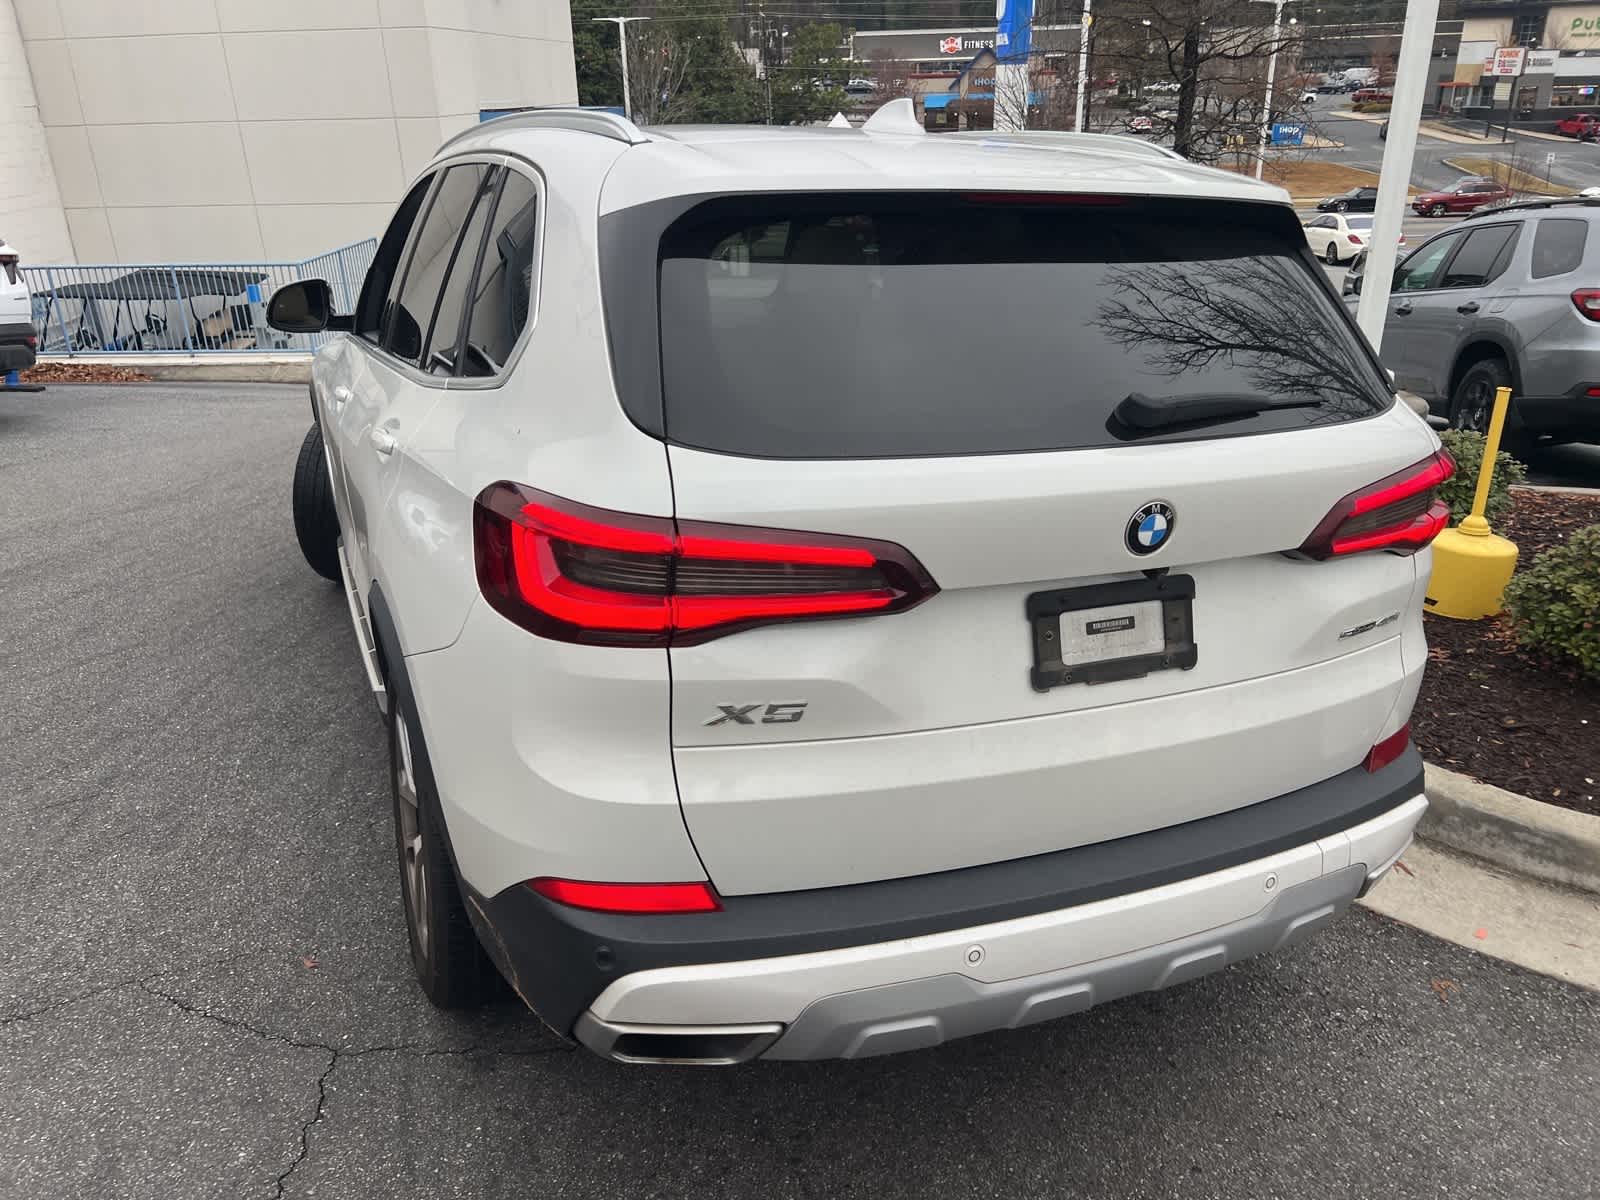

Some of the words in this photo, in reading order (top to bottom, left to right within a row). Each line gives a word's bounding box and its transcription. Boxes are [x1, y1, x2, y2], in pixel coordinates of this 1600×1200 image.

[963, 40, 994, 49] FITNESS
[1135, 504, 1173, 523] BMW
[703, 702, 809, 727] X5
